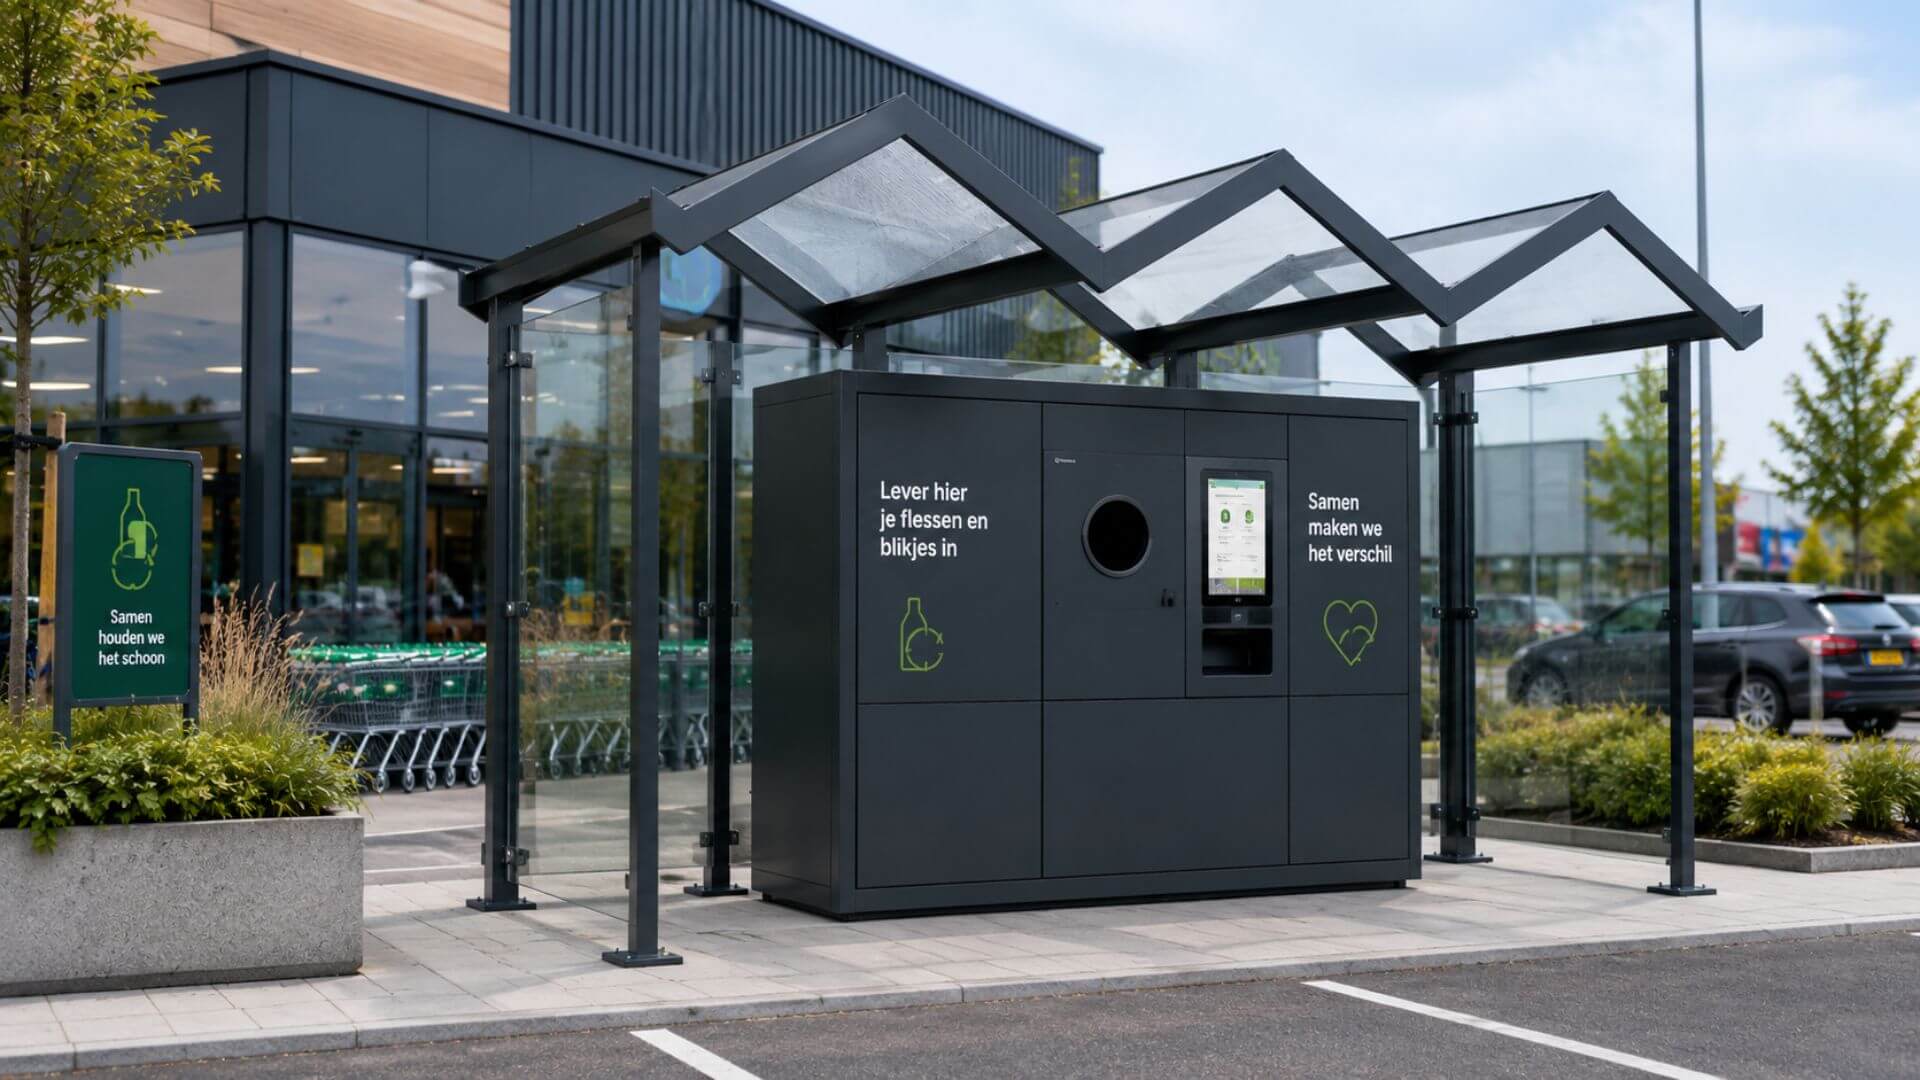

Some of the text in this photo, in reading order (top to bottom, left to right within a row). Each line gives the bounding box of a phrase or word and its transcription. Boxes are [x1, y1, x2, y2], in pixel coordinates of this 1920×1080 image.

[880, 480, 968, 502] Lever hier
[1308, 492, 1360, 511] Samen
[879, 508, 988, 532] je flessen en
[1308, 517, 1383, 537] maken we
[880, 536, 958, 561] blikjes in
[1308, 543, 1393, 563] het verschil
[110, 608, 153, 624] Samen
[98, 628, 165, 645] houden we
[98, 649, 165, 666] het schoon
